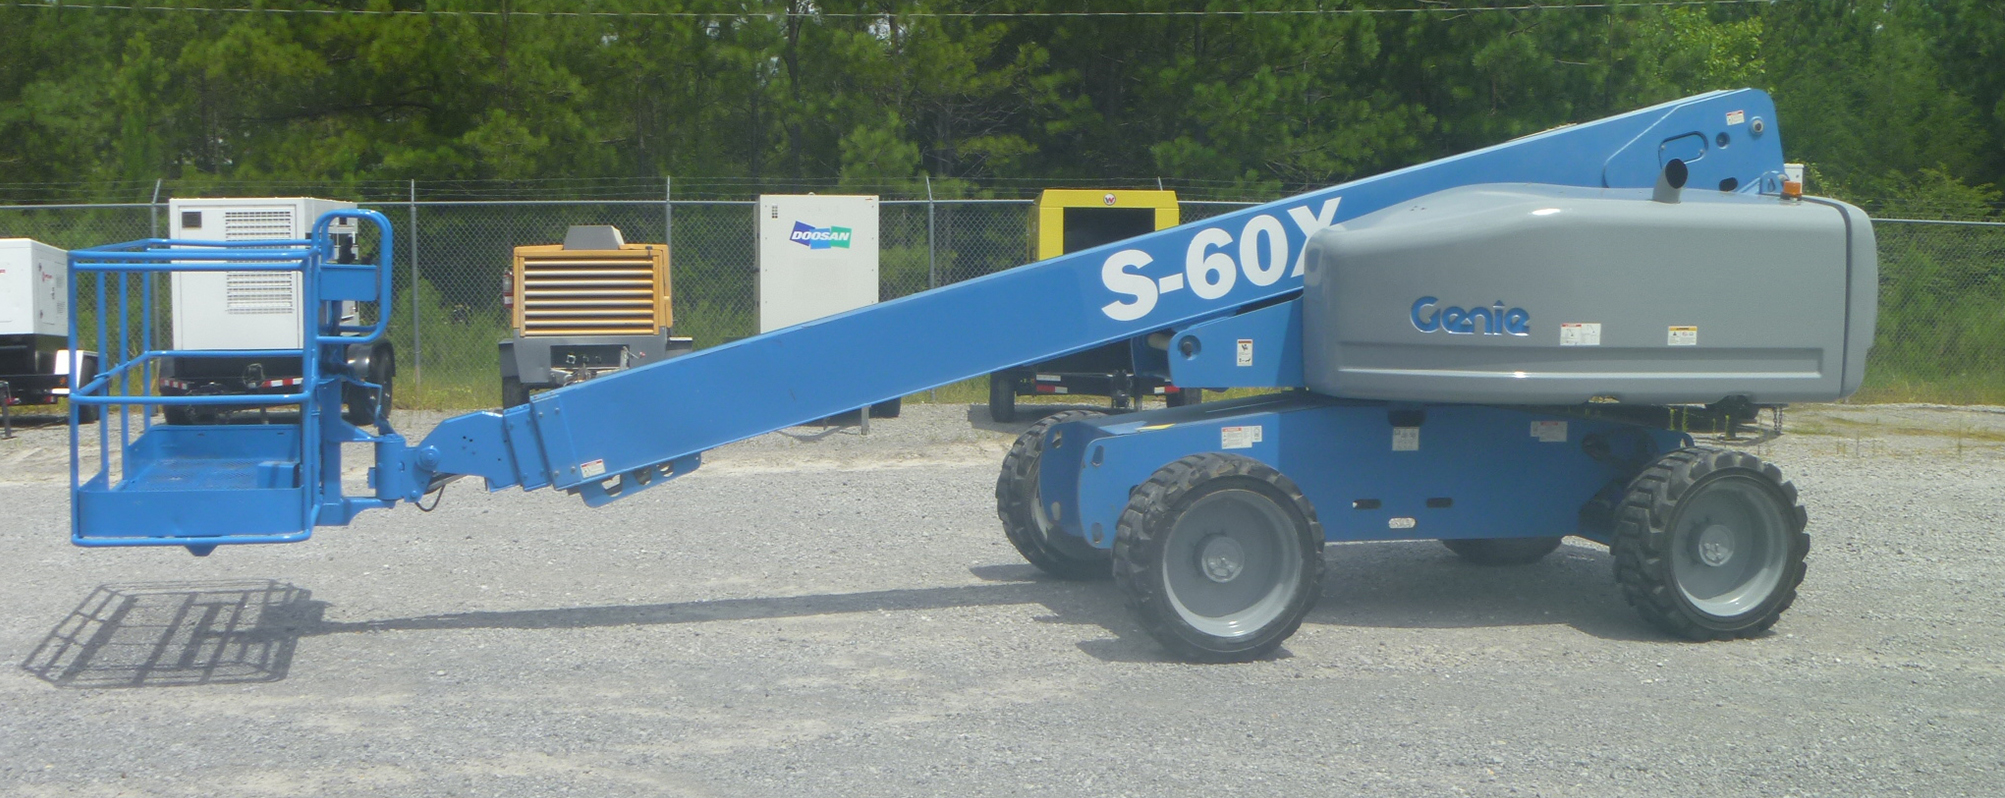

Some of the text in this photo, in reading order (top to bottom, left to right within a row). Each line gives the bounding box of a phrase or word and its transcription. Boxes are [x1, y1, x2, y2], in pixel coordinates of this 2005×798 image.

[792, 231, 850, 241] DOOSAN
[1101, 196, 1342, 321] S-60X
[1410, 296, 1530, 336] Genie
